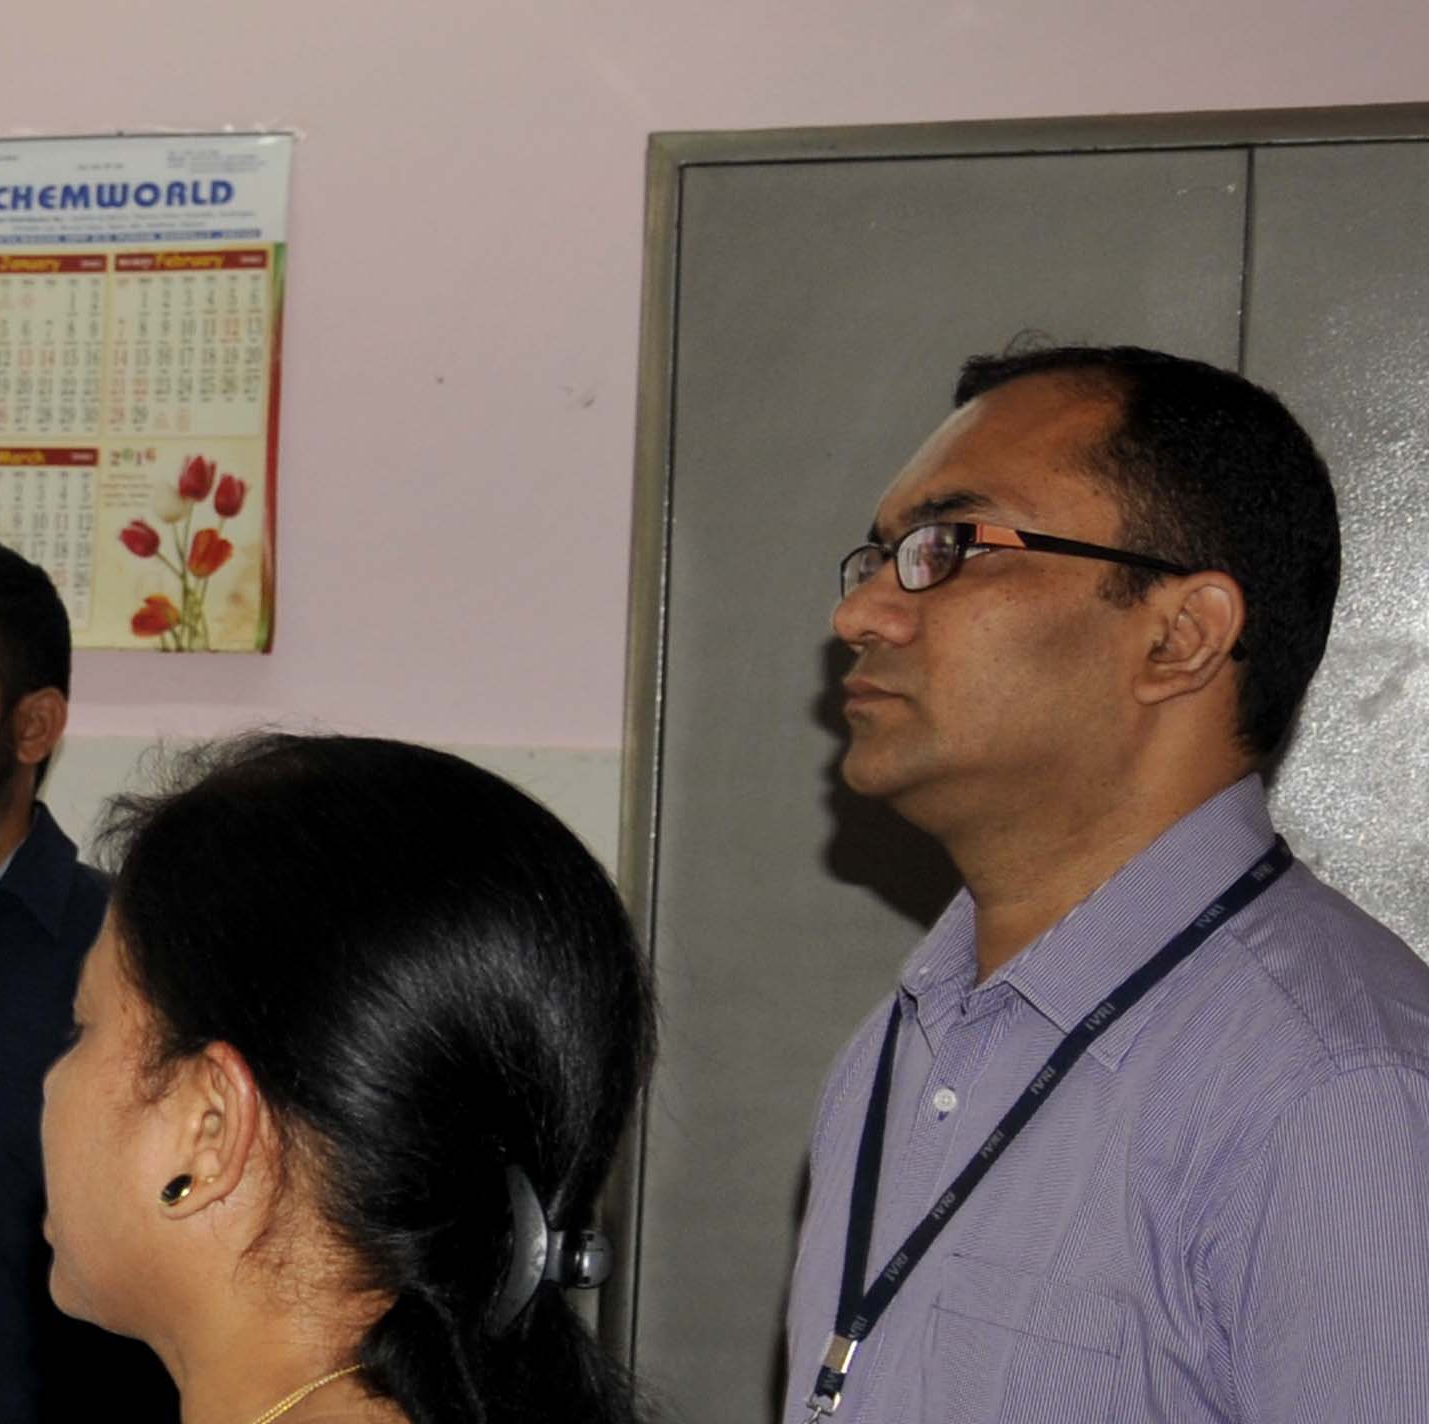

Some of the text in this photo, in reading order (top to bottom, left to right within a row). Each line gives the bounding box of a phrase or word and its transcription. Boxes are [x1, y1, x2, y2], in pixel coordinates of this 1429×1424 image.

[155, 252, 224, 271] February
[110, 448, 157, 467] 2016
[1085, 1002, 1116, 1032] IVRI
[1028, 1067, 1057, 1096] IVRI
[979, 1129, 1007, 1161] IVRI
[931, 1190, 957, 1221] IVRI
[883, 1252, 910, 1283] IVRI
